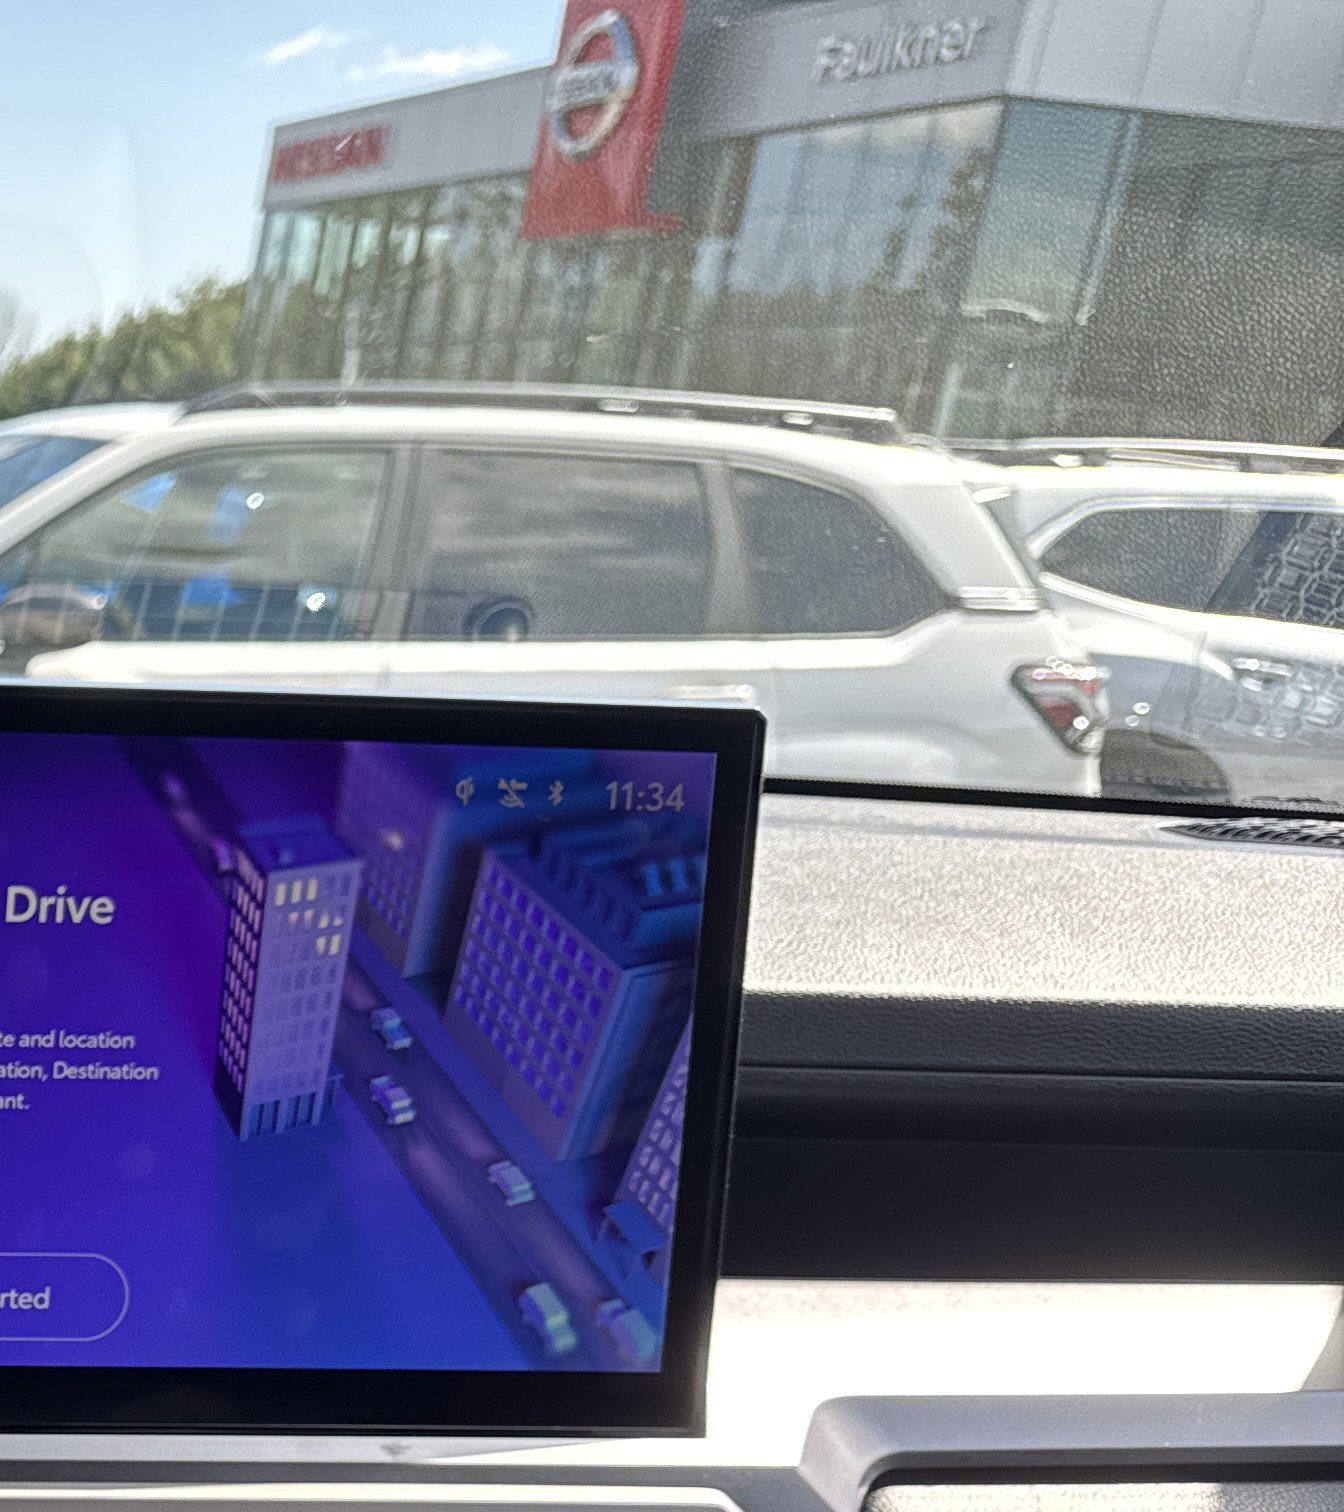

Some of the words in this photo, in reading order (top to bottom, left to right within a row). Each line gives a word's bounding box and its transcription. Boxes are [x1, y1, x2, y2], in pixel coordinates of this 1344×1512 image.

[812, 17, 990, 86] Faulkner
[606, 781, 685, 812] 11:34
[5, 885, 115, 924] Drive
[19, 1028, 56, 1048] and
[59, 1029, 136, 1049] location
[52, 1061, 159, 1080] Destination
